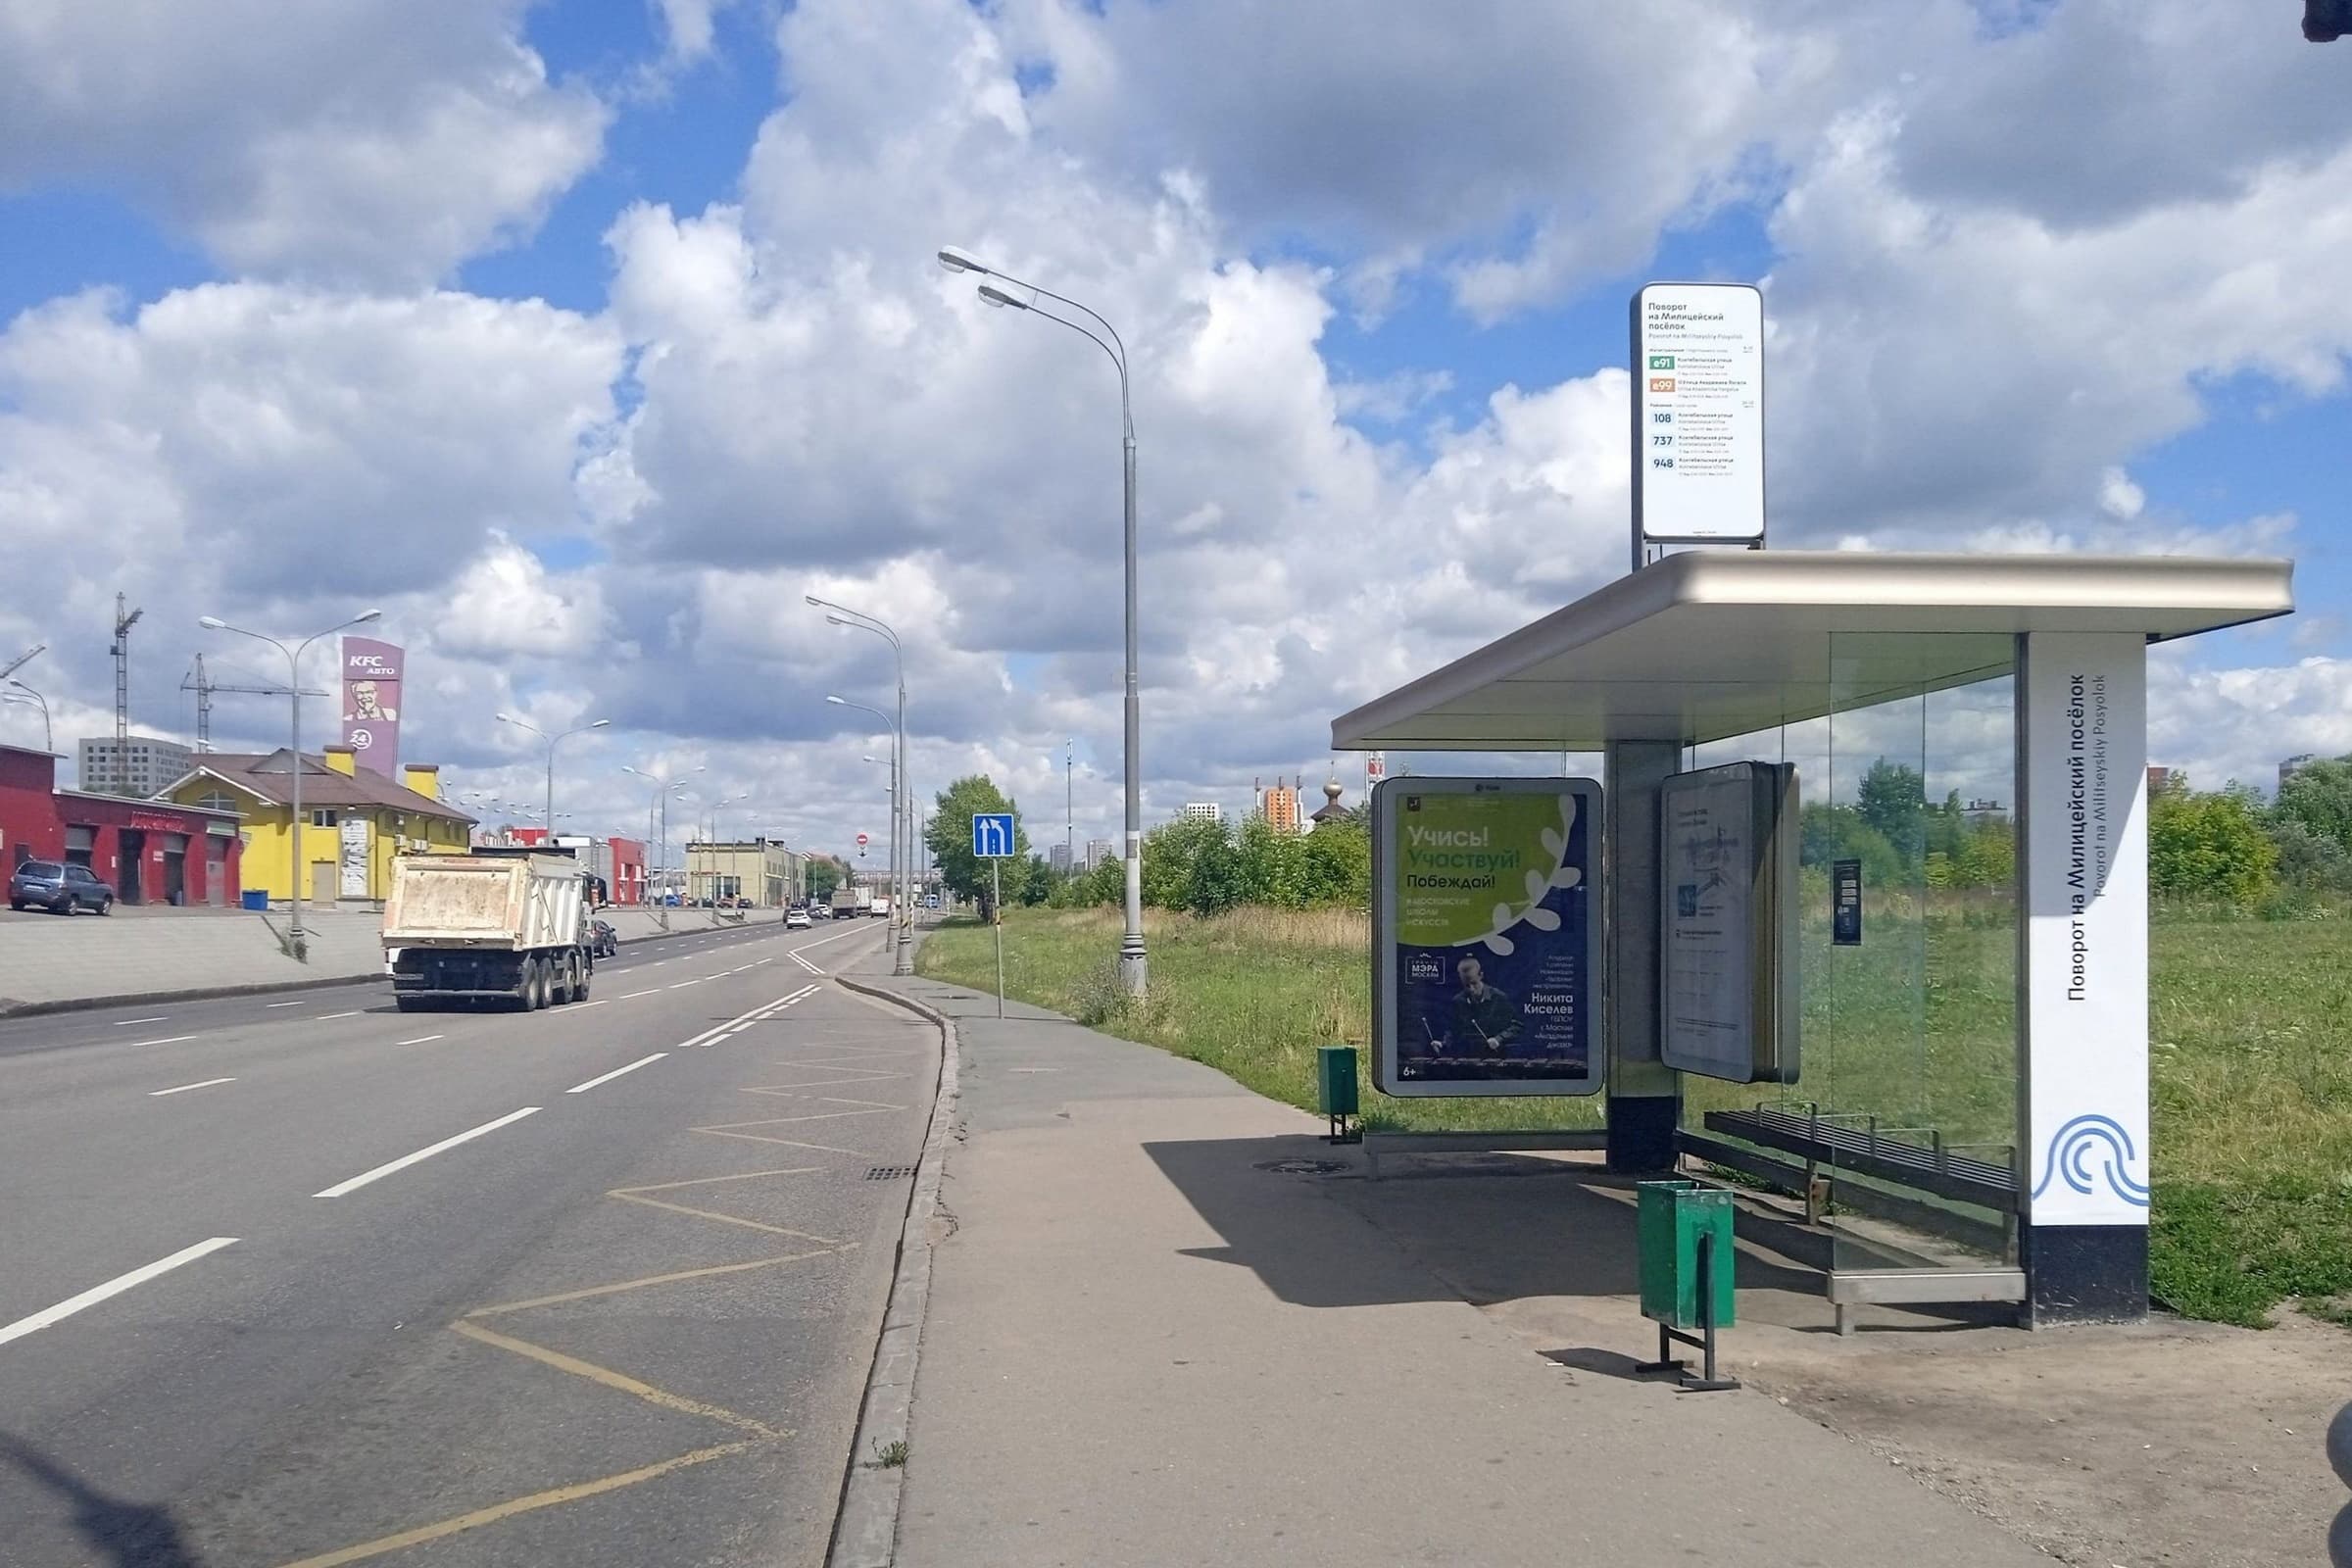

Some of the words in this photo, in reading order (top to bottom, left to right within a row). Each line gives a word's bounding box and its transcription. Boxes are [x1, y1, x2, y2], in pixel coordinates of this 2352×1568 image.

[1648, 302, 1688, 312] Поворот
[1661, 313, 1724, 321] Милицейский
[1648, 321, 1686, 330] посёлок
[1654, 413, 1672, 423] 108
[1653, 436, 1673, 446] 737
[1653, 459, 1674, 468] 948
[349, 656, 383, 666] KFC
[2092, 674, 2108, 735] Posyolok
[2067, 674, 2085, 751] посёлок
[2067, 757, 2087, 889] Милицейский
[1407, 826, 1490, 847] Учись!
[2096, 825, 2106, 841] na
[1408, 849, 1520, 871] Участвуй!
[2093, 845, 2106, 898] Povorot
[1406, 874, 1495, 891] Побеждай!
[2072, 894, 2085, 914] на
[2068, 920, 2088, 1001] Поворот
[1532, 993, 1574, 1004] Никита
[1524, 1004, 1574, 1014] Киселев
[1402, 1066, 1416, 1076] 6+
